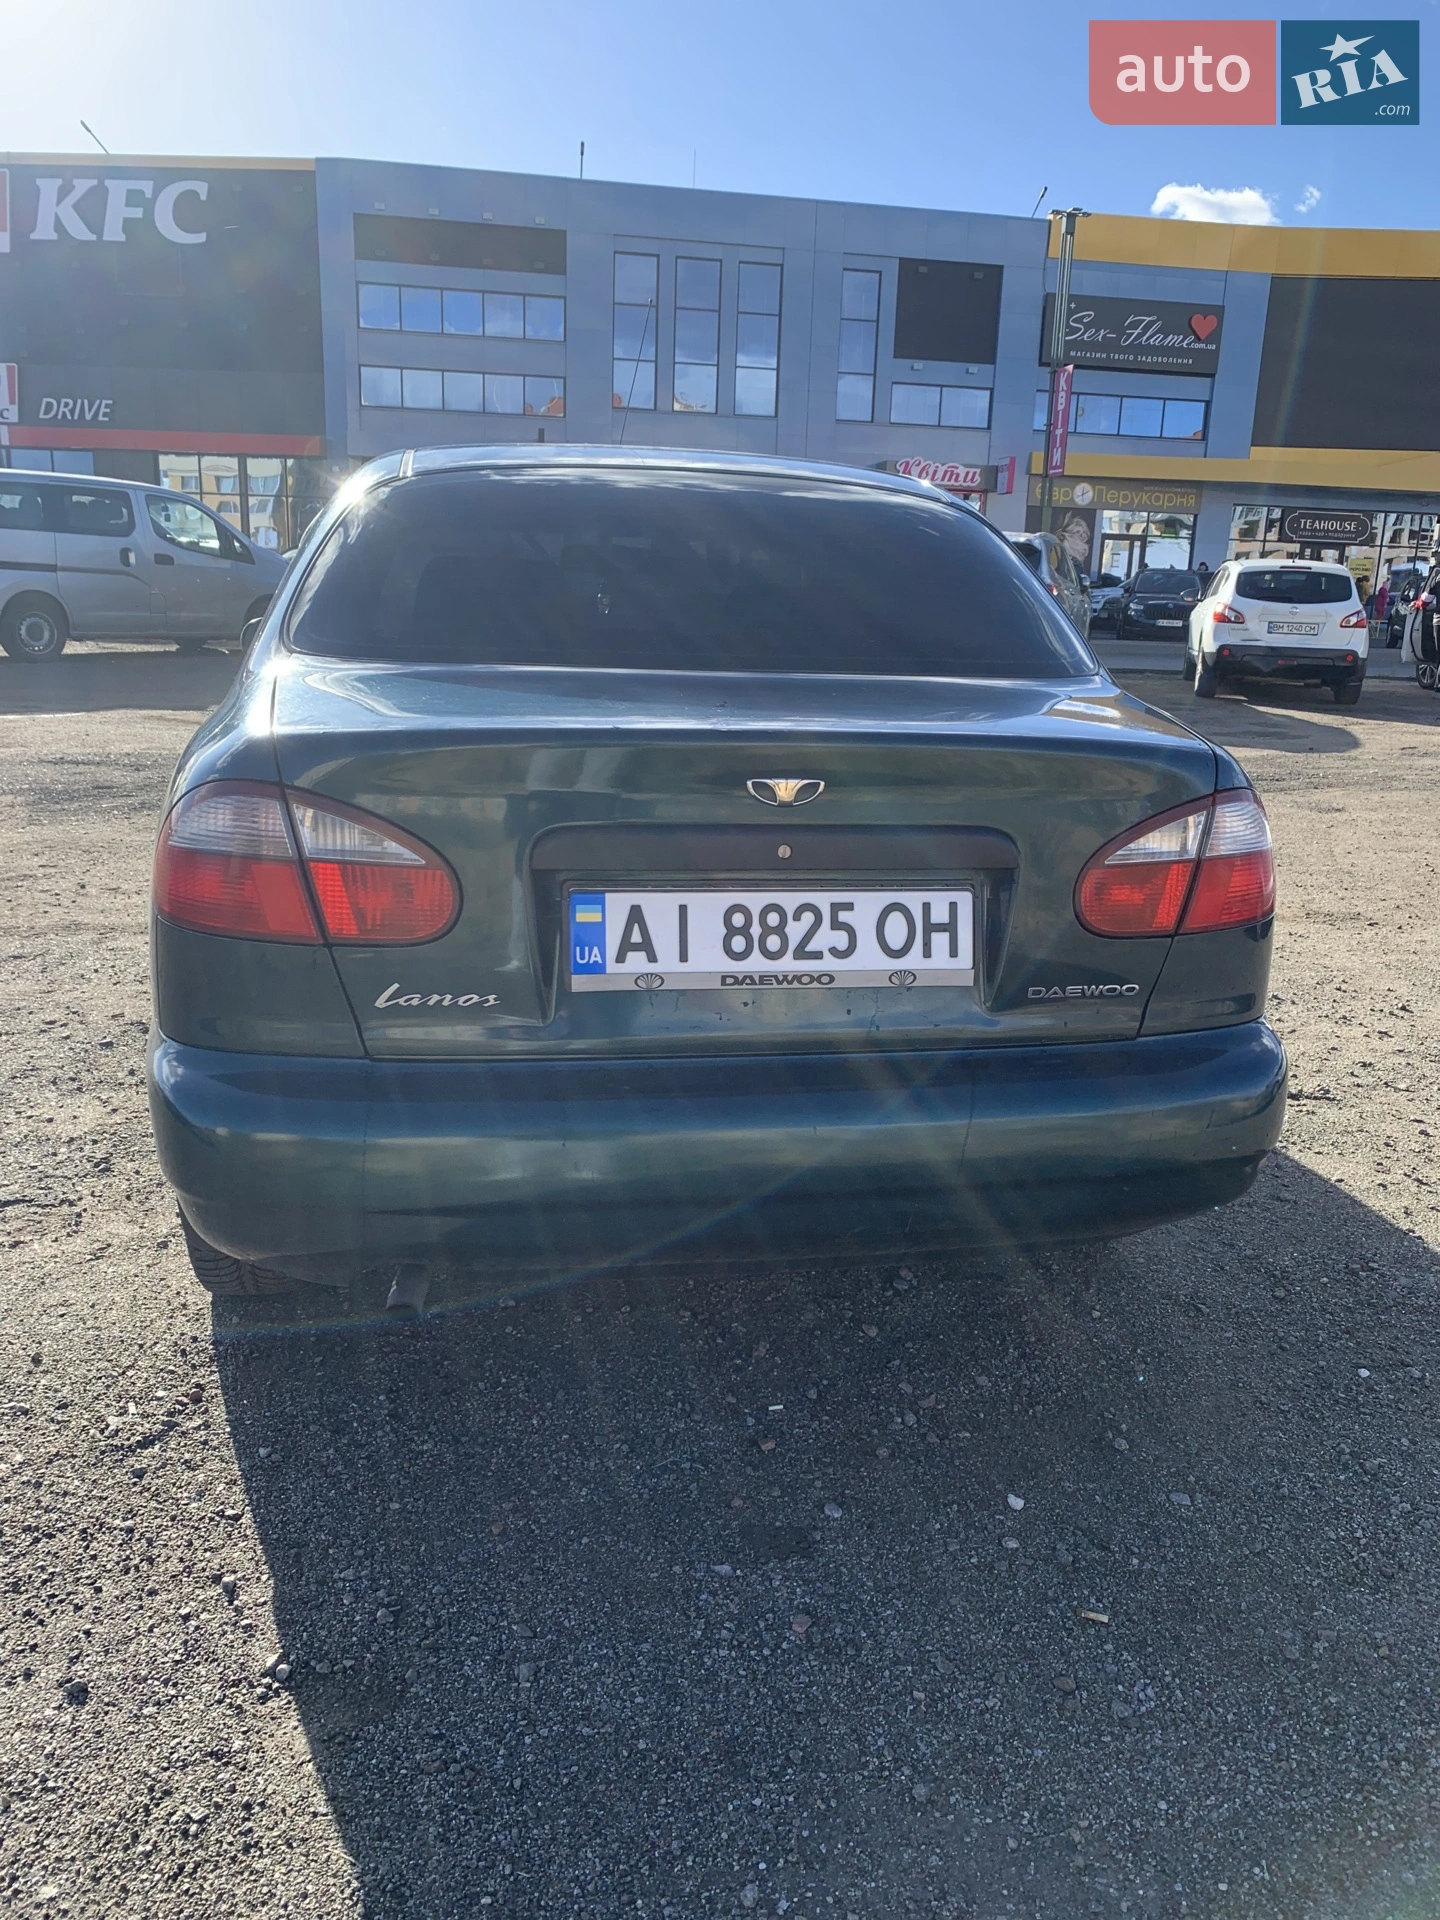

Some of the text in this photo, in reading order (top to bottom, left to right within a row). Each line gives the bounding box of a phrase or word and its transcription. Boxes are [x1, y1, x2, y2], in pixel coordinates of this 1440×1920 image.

[30, 178, 209, 244] KFC
[1070, 350, 1193, 364] МАГАЗИН ТВОГО ЗАДОВОЛЕННЯ
[39, 397, 113, 421] DRIVE
[1053, 372, 1067, 466] КВІТИ
[897, 458, 980, 486] Квіти
[1299, 519, 1358, 532] TEAHOUSE
[1272, 623, 1316, 634] BM 1240 CM
[615, 901, 959, 964] AI 8825 OH
[575, 946, 602, 964] UA
[720, 973, 836, 987] DAEWOO
[374, 982, 501, 1009] Lanos
[1027, 984, 1140, 999] DAEWOO
